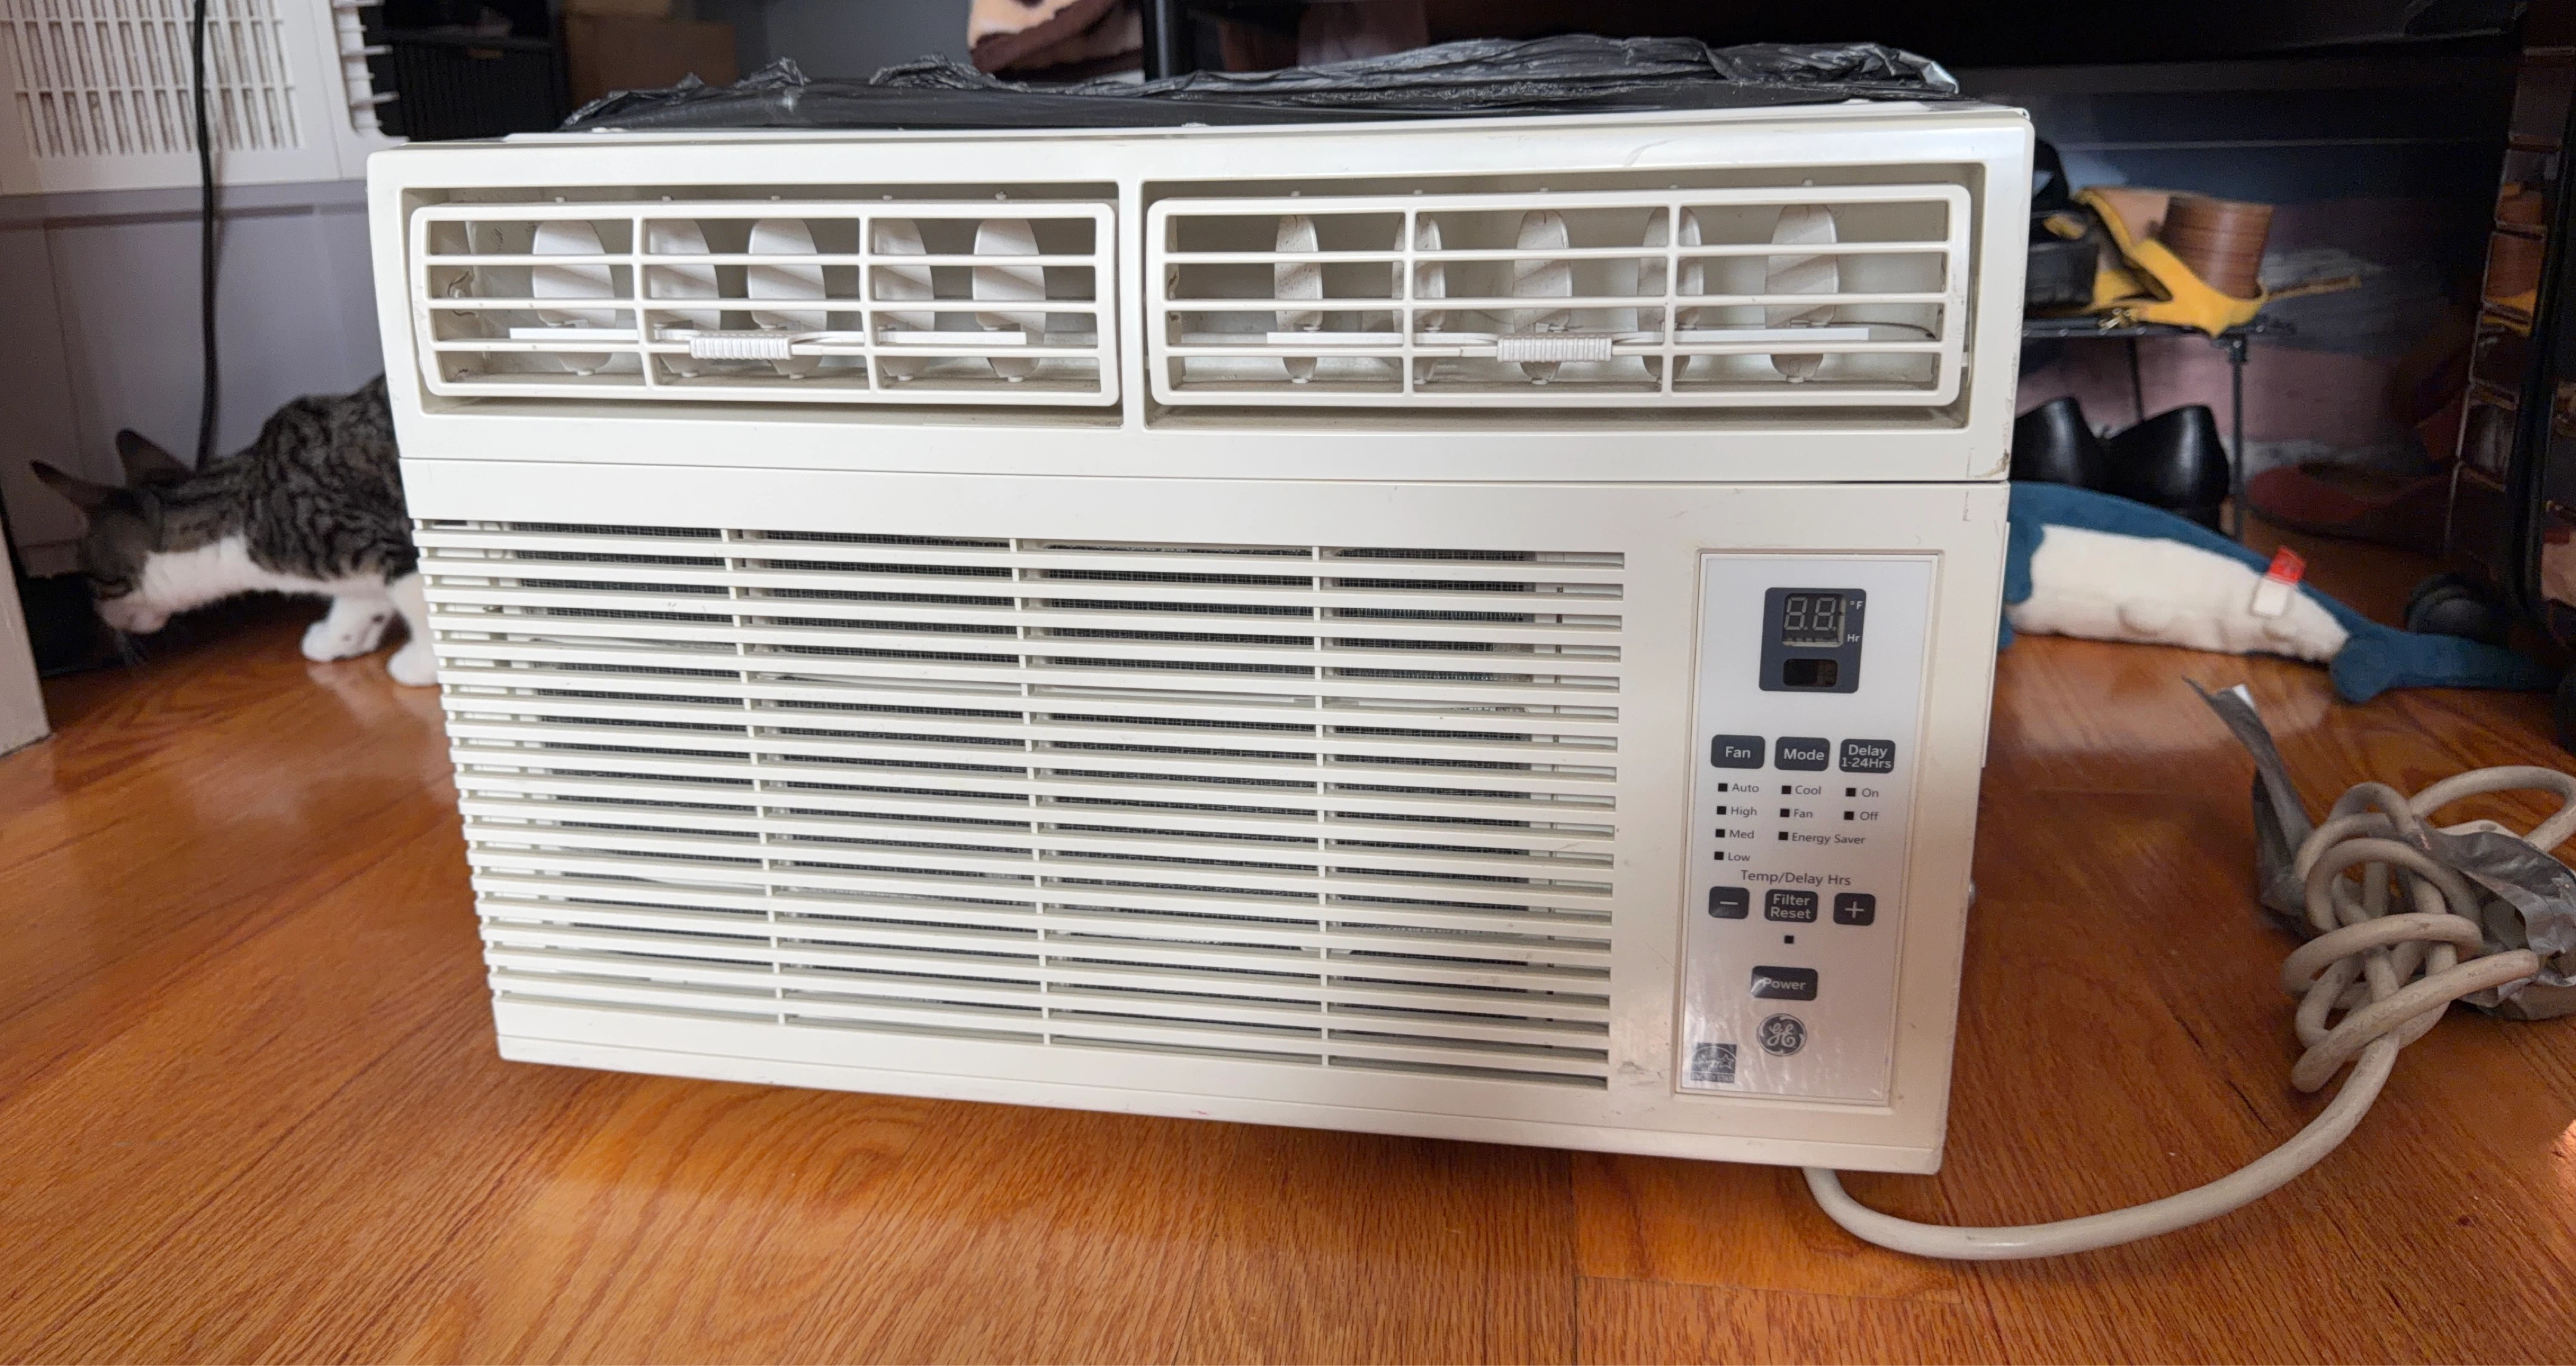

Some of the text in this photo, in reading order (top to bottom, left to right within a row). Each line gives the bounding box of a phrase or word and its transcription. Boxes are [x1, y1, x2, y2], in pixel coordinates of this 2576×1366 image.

[1847, 633, 1860, 643] Hr
[1725, 746, 1751, 759] Fan
[1784, 748, 1825, 761] Mode
[1848, 744, 1888, 758] Delay
[1841, 757, 1892, 770] 1-24Hrs
[1732, 783, 1760, 794] Auto
[1795, 785, 1822, 796] Cool
[1861, 788, 1880, 798] On
[1730, 806, 1758, 818] High
[1793, 808, 1813, 819] Fan
[1859, 811, 1880, 822] Off
[1729, 829, 1755, 840] Med
[1791, 832, 1866, 845] Energy Saver
[1727, 852, 1751, 862] Low
[1740, 869, 1852, 887] Temp/Delay Hrs
[1772, 893, 1811, 907] Filter
[1770, 906, 1812, 920] Reset
[1762, 977, 1807, 991] Power
